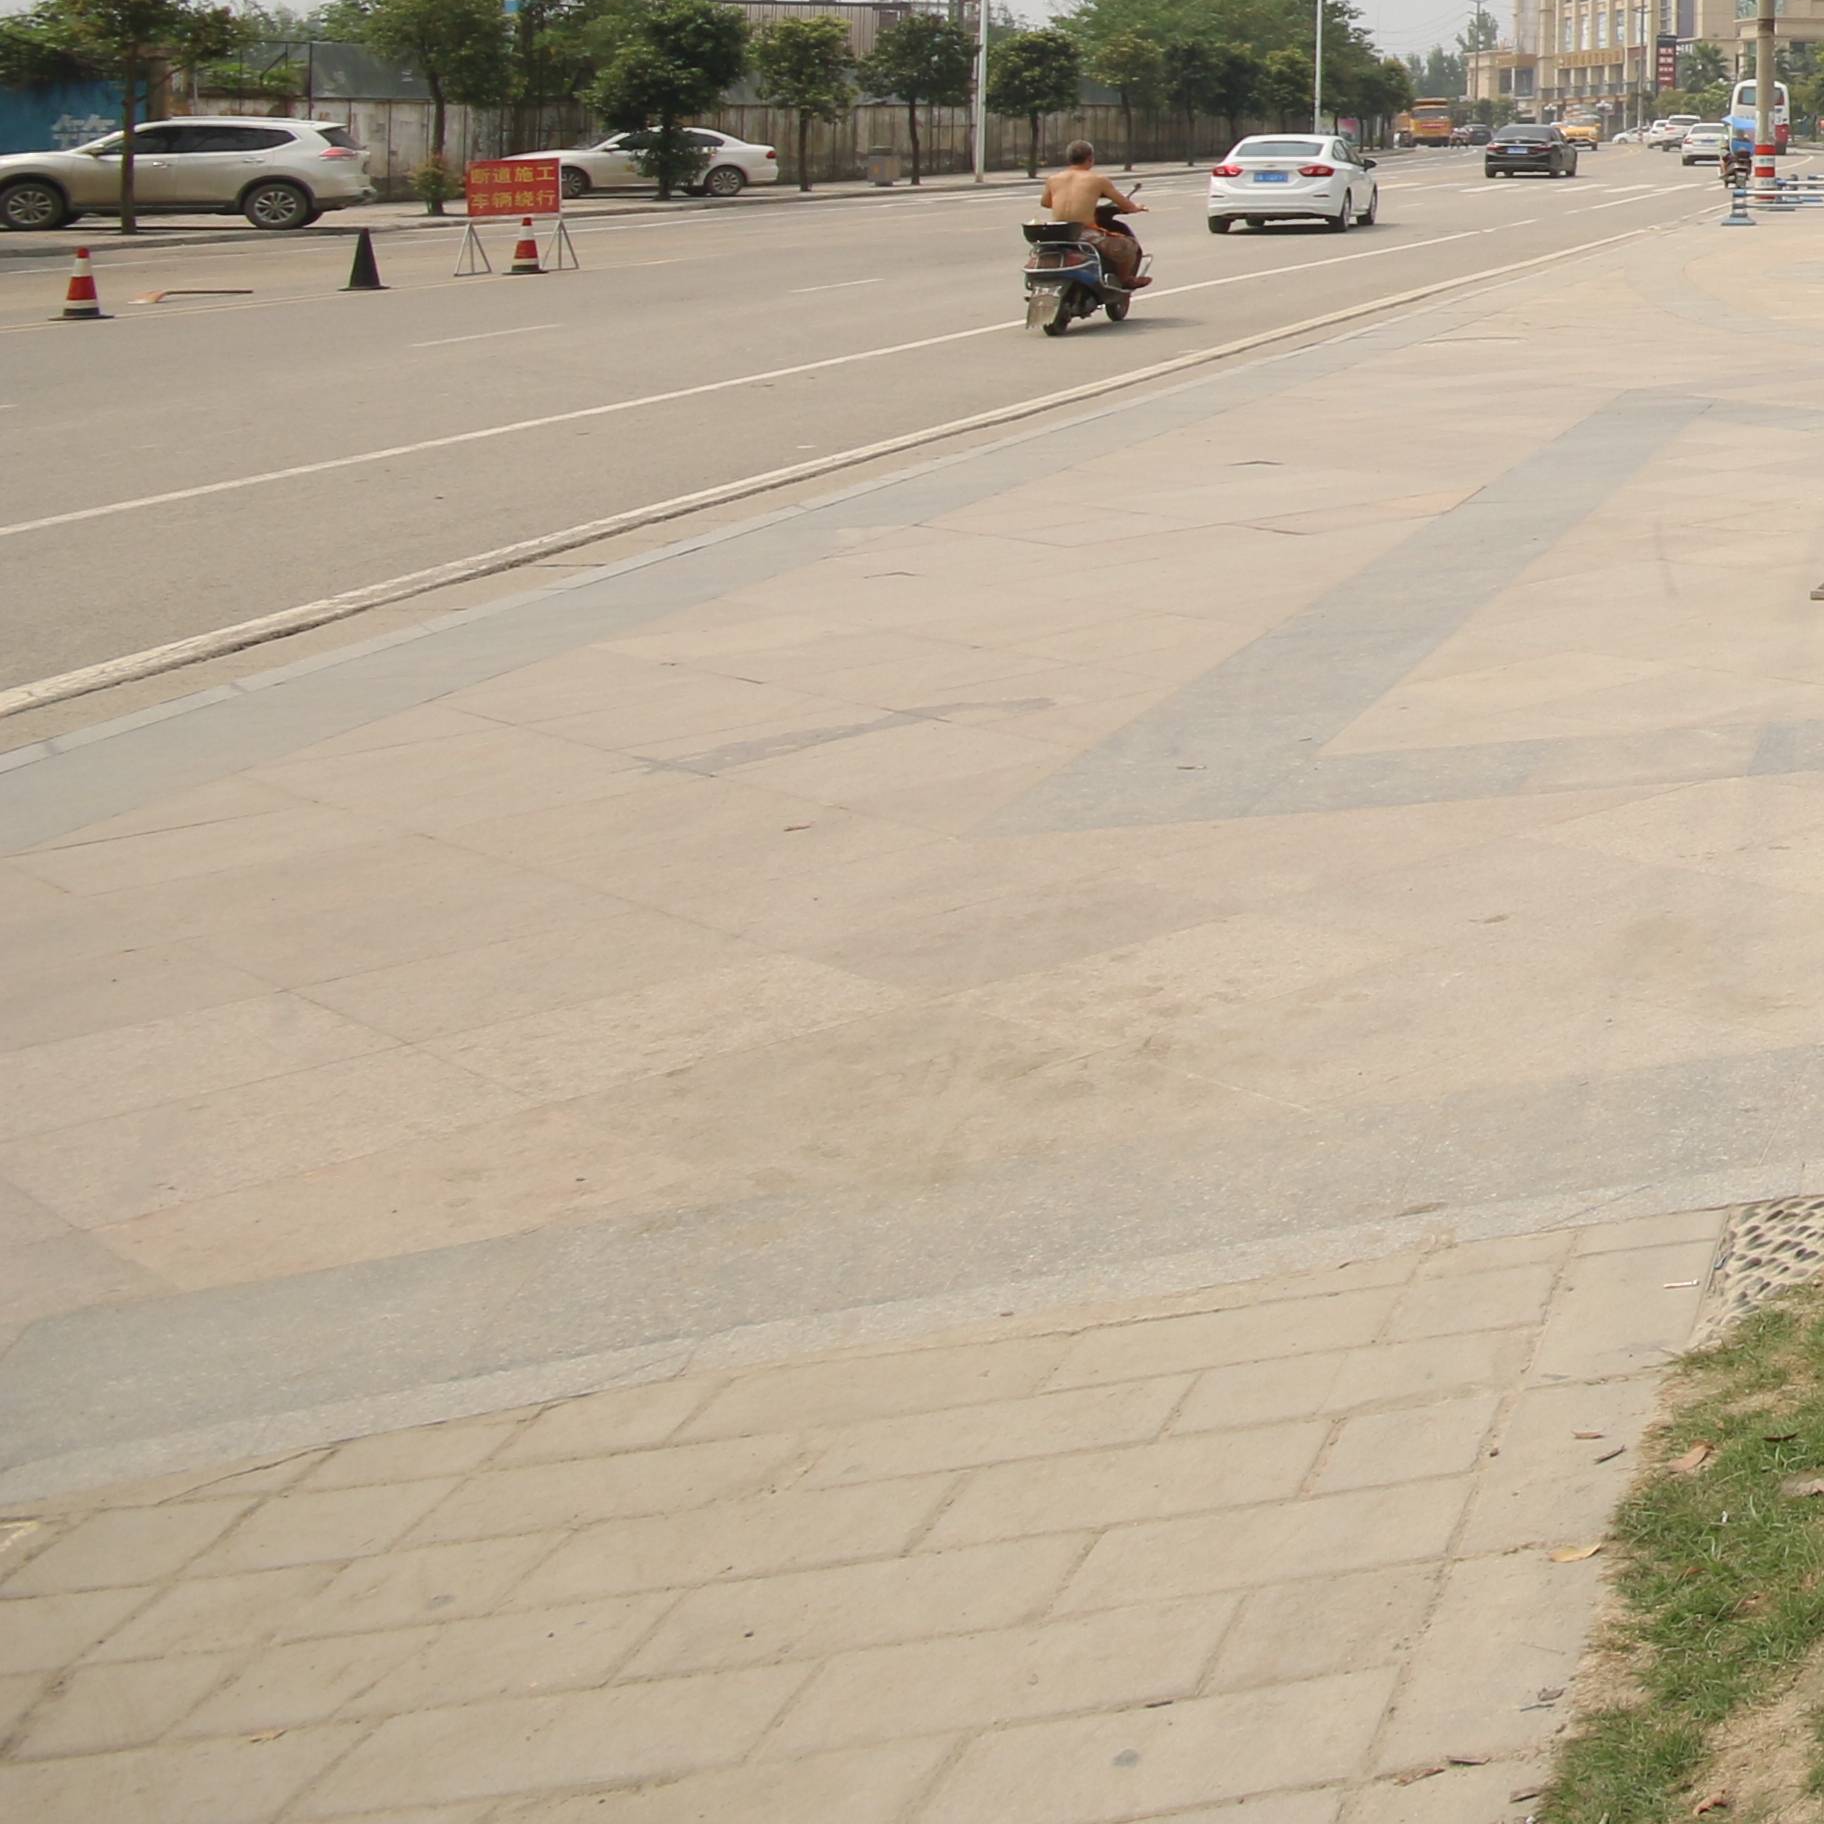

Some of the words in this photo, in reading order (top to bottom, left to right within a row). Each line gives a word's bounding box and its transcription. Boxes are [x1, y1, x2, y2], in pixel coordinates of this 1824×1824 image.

[470, 167, 555, 184] 断道施工
[471, 191, 555, 208] 车辆绕行
